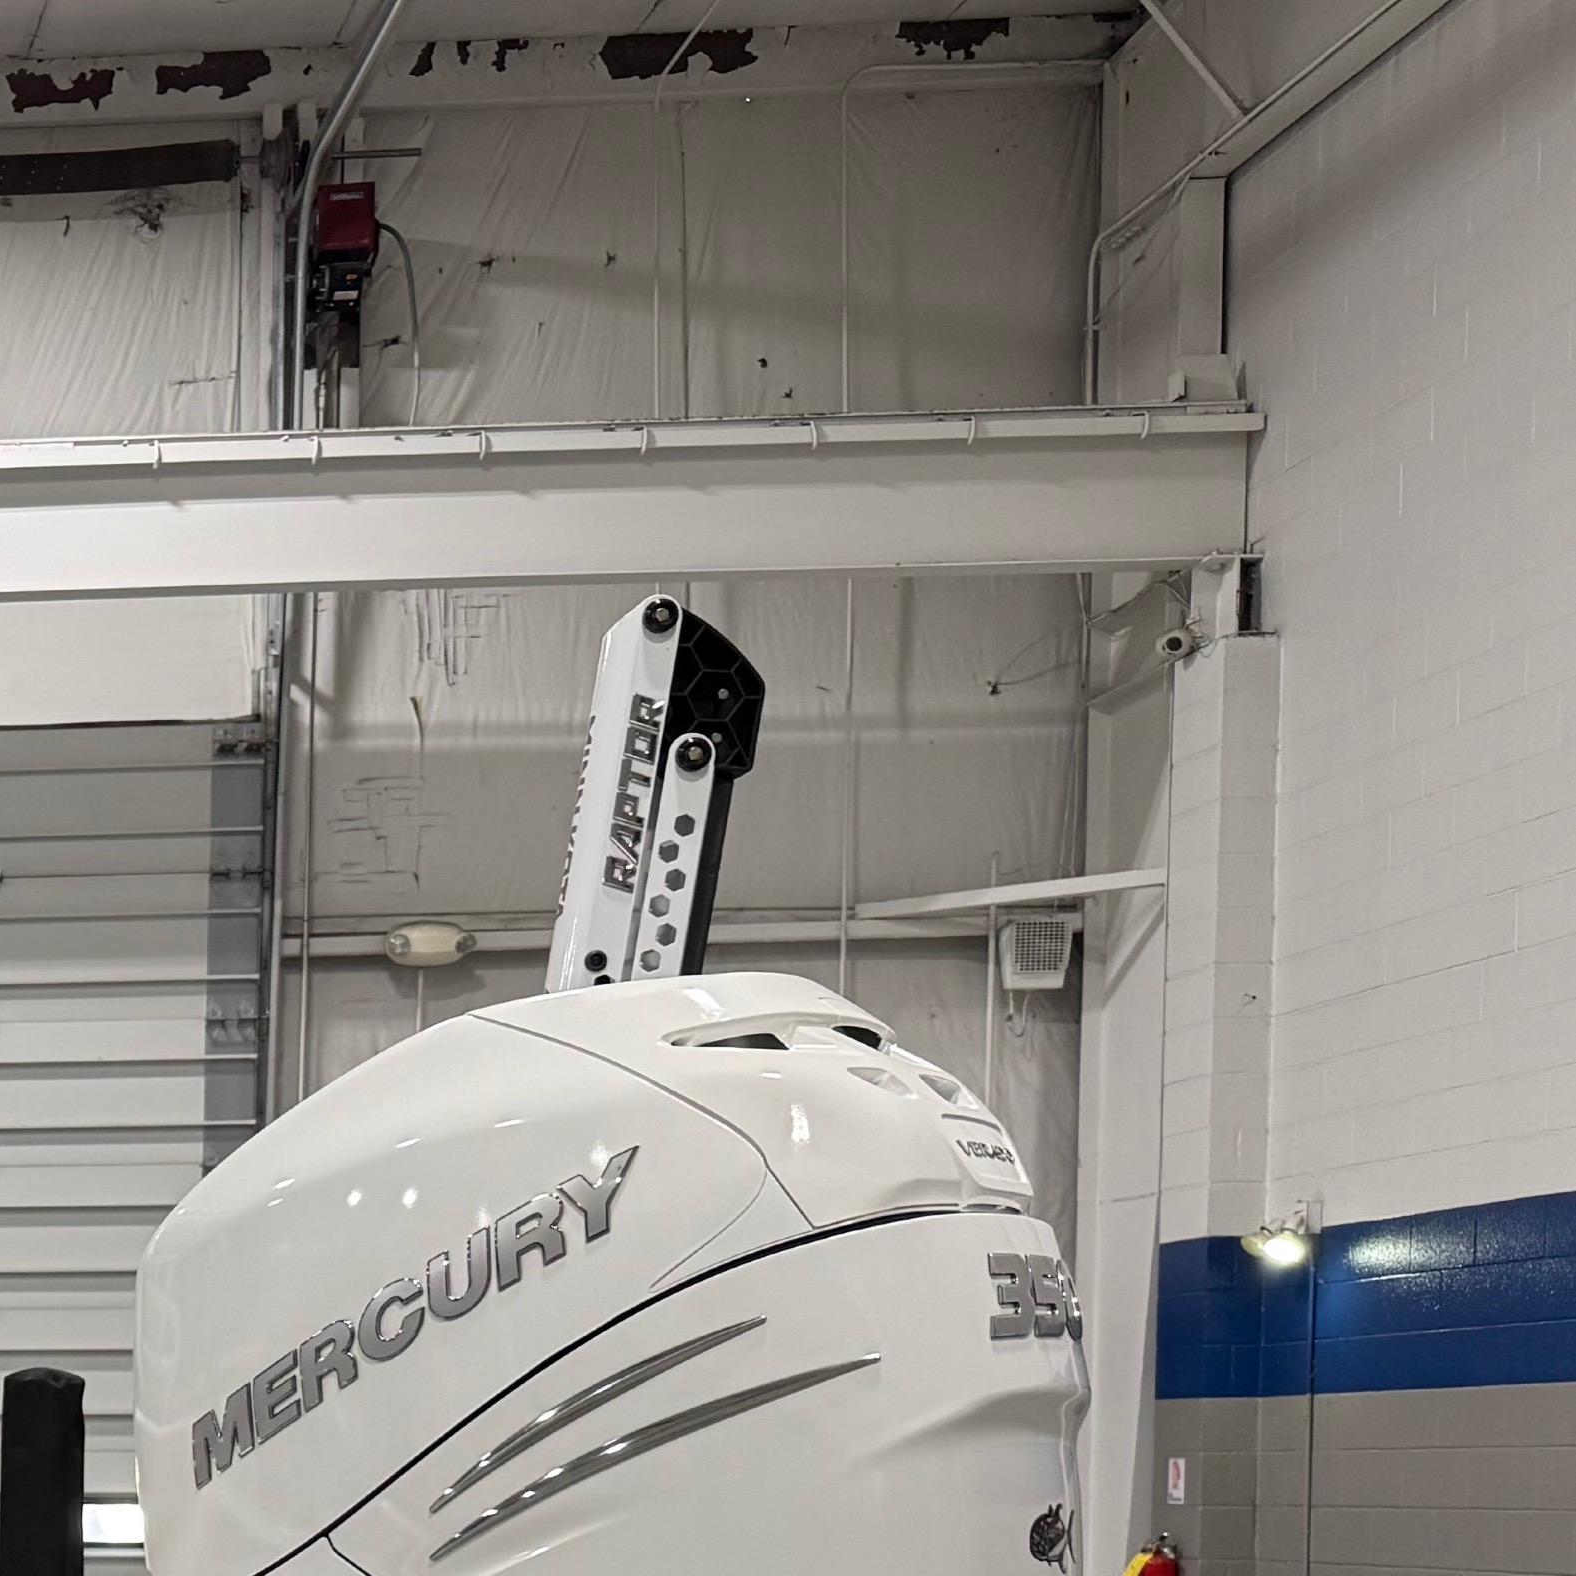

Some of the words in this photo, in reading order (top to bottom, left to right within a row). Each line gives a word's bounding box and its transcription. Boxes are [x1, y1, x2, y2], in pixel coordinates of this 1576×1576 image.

[602, 693, 665, 894] RAPTOR
[191, 1145, 640, 1490] MERCURY
[988, 1252, 1084, 1342] 350
